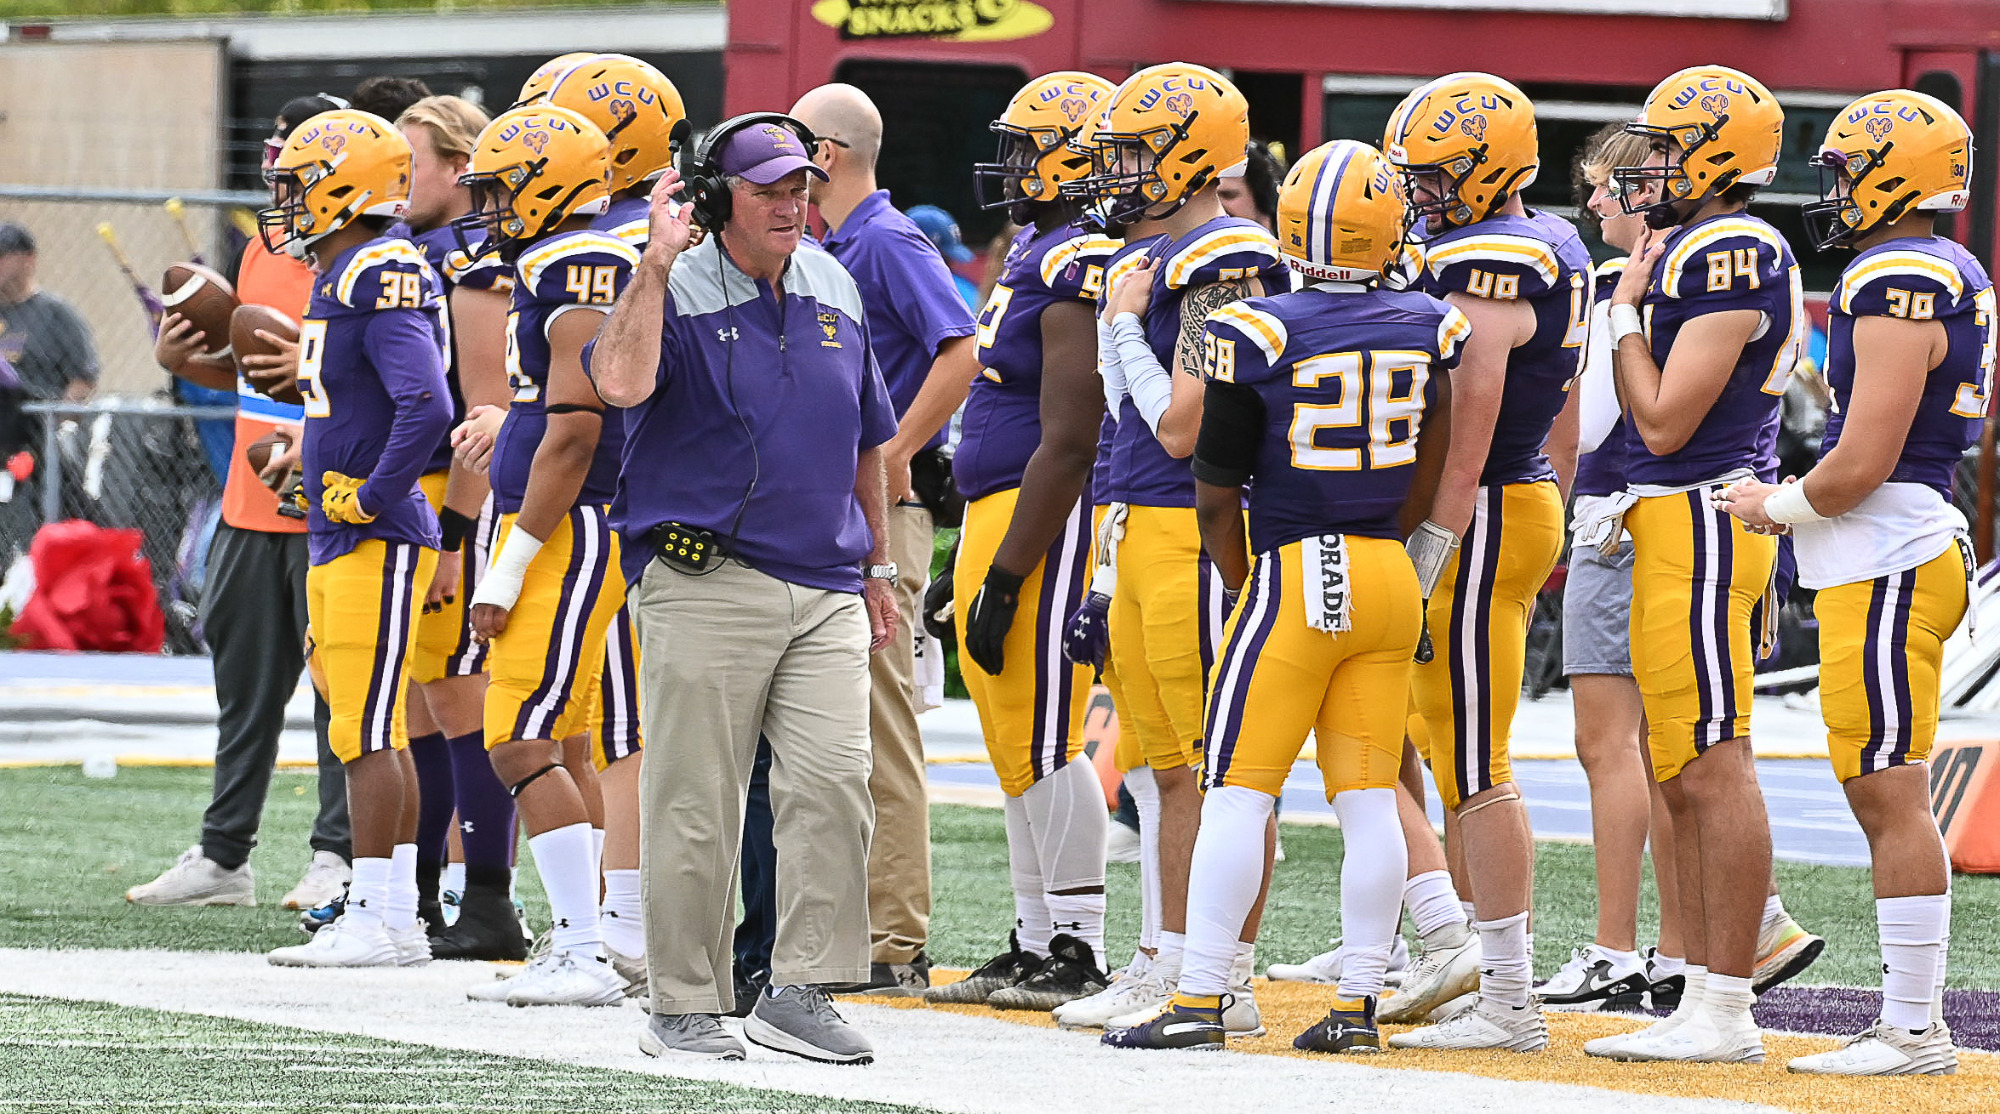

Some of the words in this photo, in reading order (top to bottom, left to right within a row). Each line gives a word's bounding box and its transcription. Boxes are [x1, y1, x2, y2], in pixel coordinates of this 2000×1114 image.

[849, 4, 978, 36] SNACKS
[588, 81, 655, 105] WCU
[1139, 78, 1204, 109] WCU
[1674, 79, 1743, 107] WCU
[1433, 95, 1498, 133] WCU
[1847, 103, 1919, 124] WCU
[302, 122, 366, 144] WCU
[500, 118, 567, 142] WCU
[1953, 163, 1965, 177] 38
[566, 265, 618, 304] 49
[1290, 259, 1351, 280] Riddell
[1706, 248, 1760, 292] 84
[375, 271, 421, 310] 39
[1204, 331, 1236, 384] 28
[1288, 350, 1431, 471] 28
